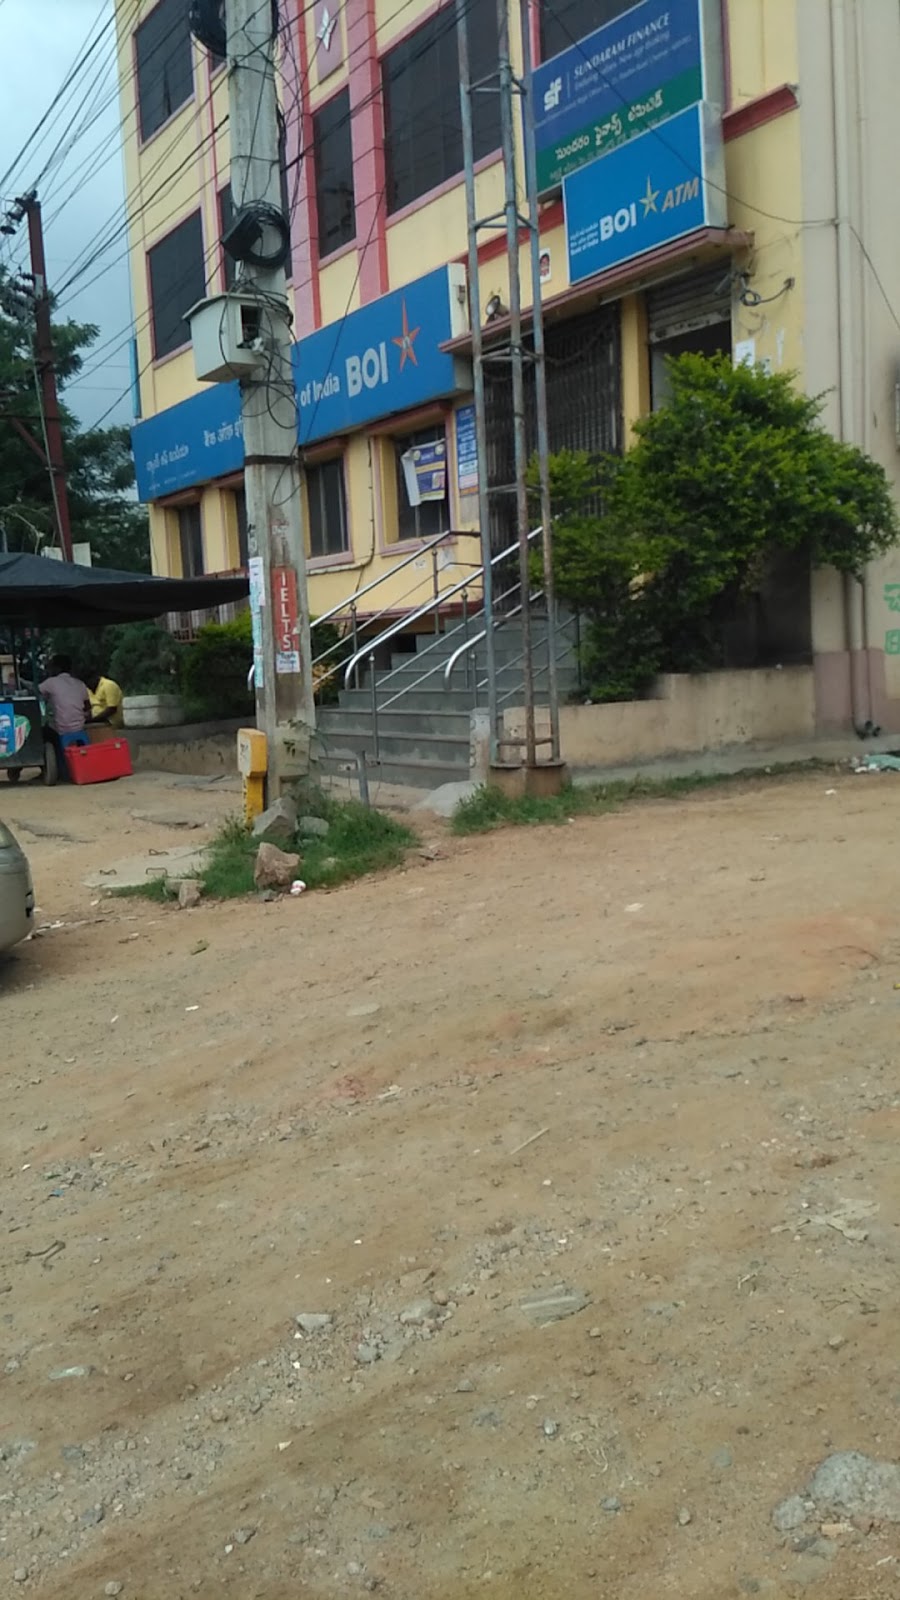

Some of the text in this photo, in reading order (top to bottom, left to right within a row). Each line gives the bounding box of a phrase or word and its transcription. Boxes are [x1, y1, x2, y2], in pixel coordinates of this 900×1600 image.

[574, 40, 626, 77] SUNDARAM
[627, 13, 670, 48] FINANCE
[600, 202, 637, 241] BOI
[662, 177, 700, 213] ATM
[300, 341, 389, 407] of India BOI
[281, 572, 291, 649] IELTS
